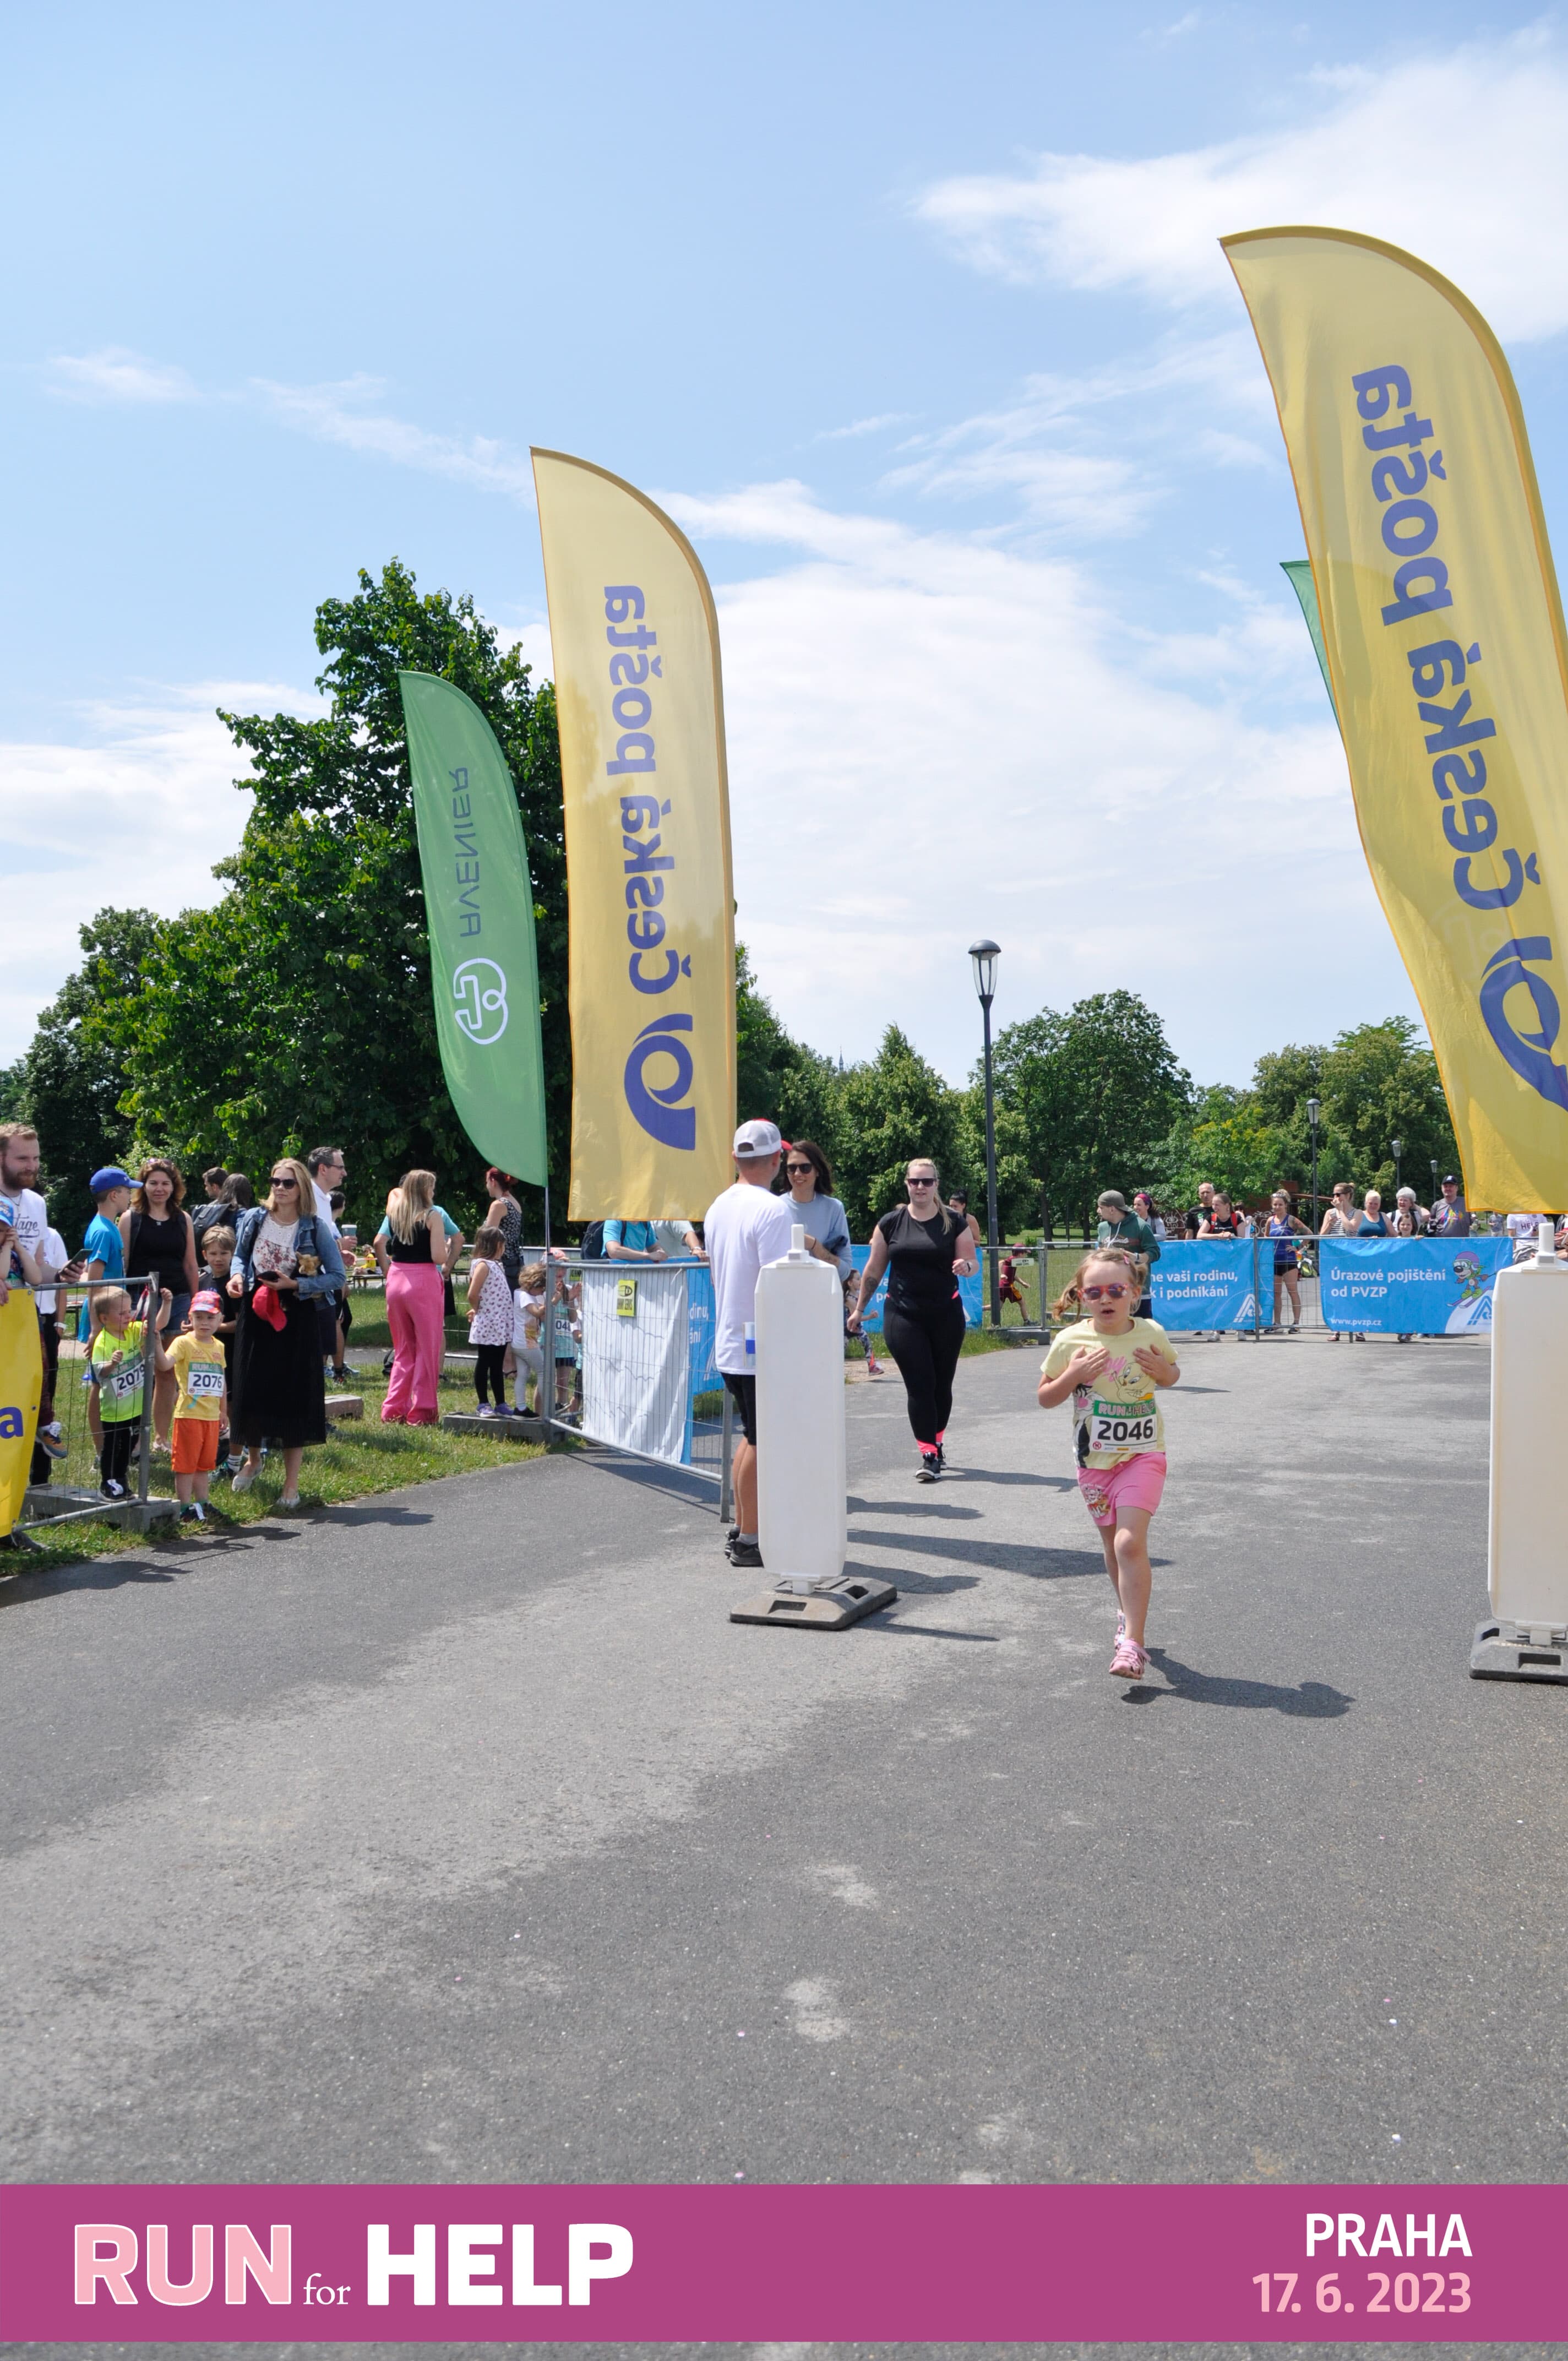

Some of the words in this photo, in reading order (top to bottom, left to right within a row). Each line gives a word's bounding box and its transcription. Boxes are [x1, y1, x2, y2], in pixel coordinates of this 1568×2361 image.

[1166, 1270, 1191, 1282] vaši
[1194, 1270, 1238, 1282] rodinu,
[1331, 1266, 1384, 1281] Úrazové
[1387, 1268, 1446, 1283] pojištění
[1159, 1287, 1163, 1298] i
[1167, 1285, 1228, 1301] podnikání
[1331, 1286, 1348, 1297] od
[1352, 1287, 1387, 1297] PVZP
[117, 1363, 145, 1391] 2079
[193, 1374, 222, 1389] 2076
[1098, 1403, 1125, 1416] RUN
[1097, 1418, 1153, 1441] 2046
